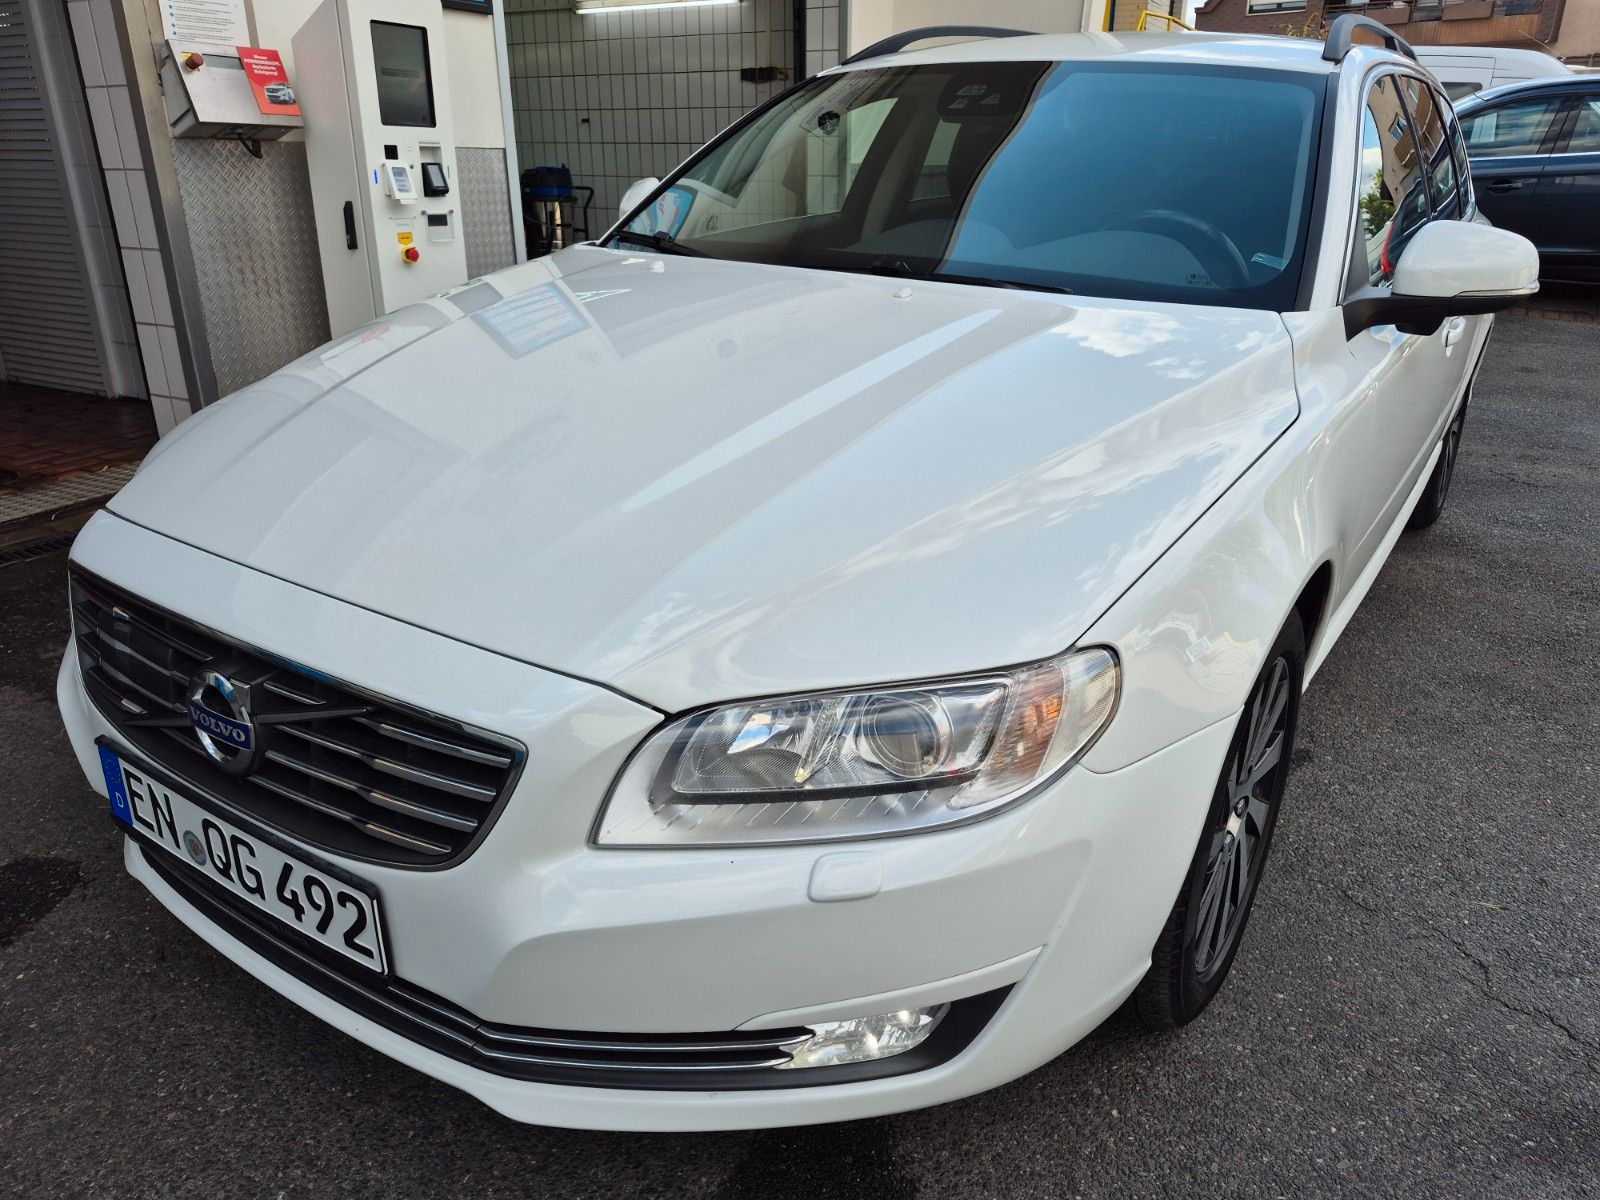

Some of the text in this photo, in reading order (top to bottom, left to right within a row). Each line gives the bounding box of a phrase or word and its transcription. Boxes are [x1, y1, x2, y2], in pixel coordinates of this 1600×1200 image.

[190, 704, 246, 742] VOLVO
[115, 792, 124, 808] D
[122, 767, 375, 960] EN QG 492
